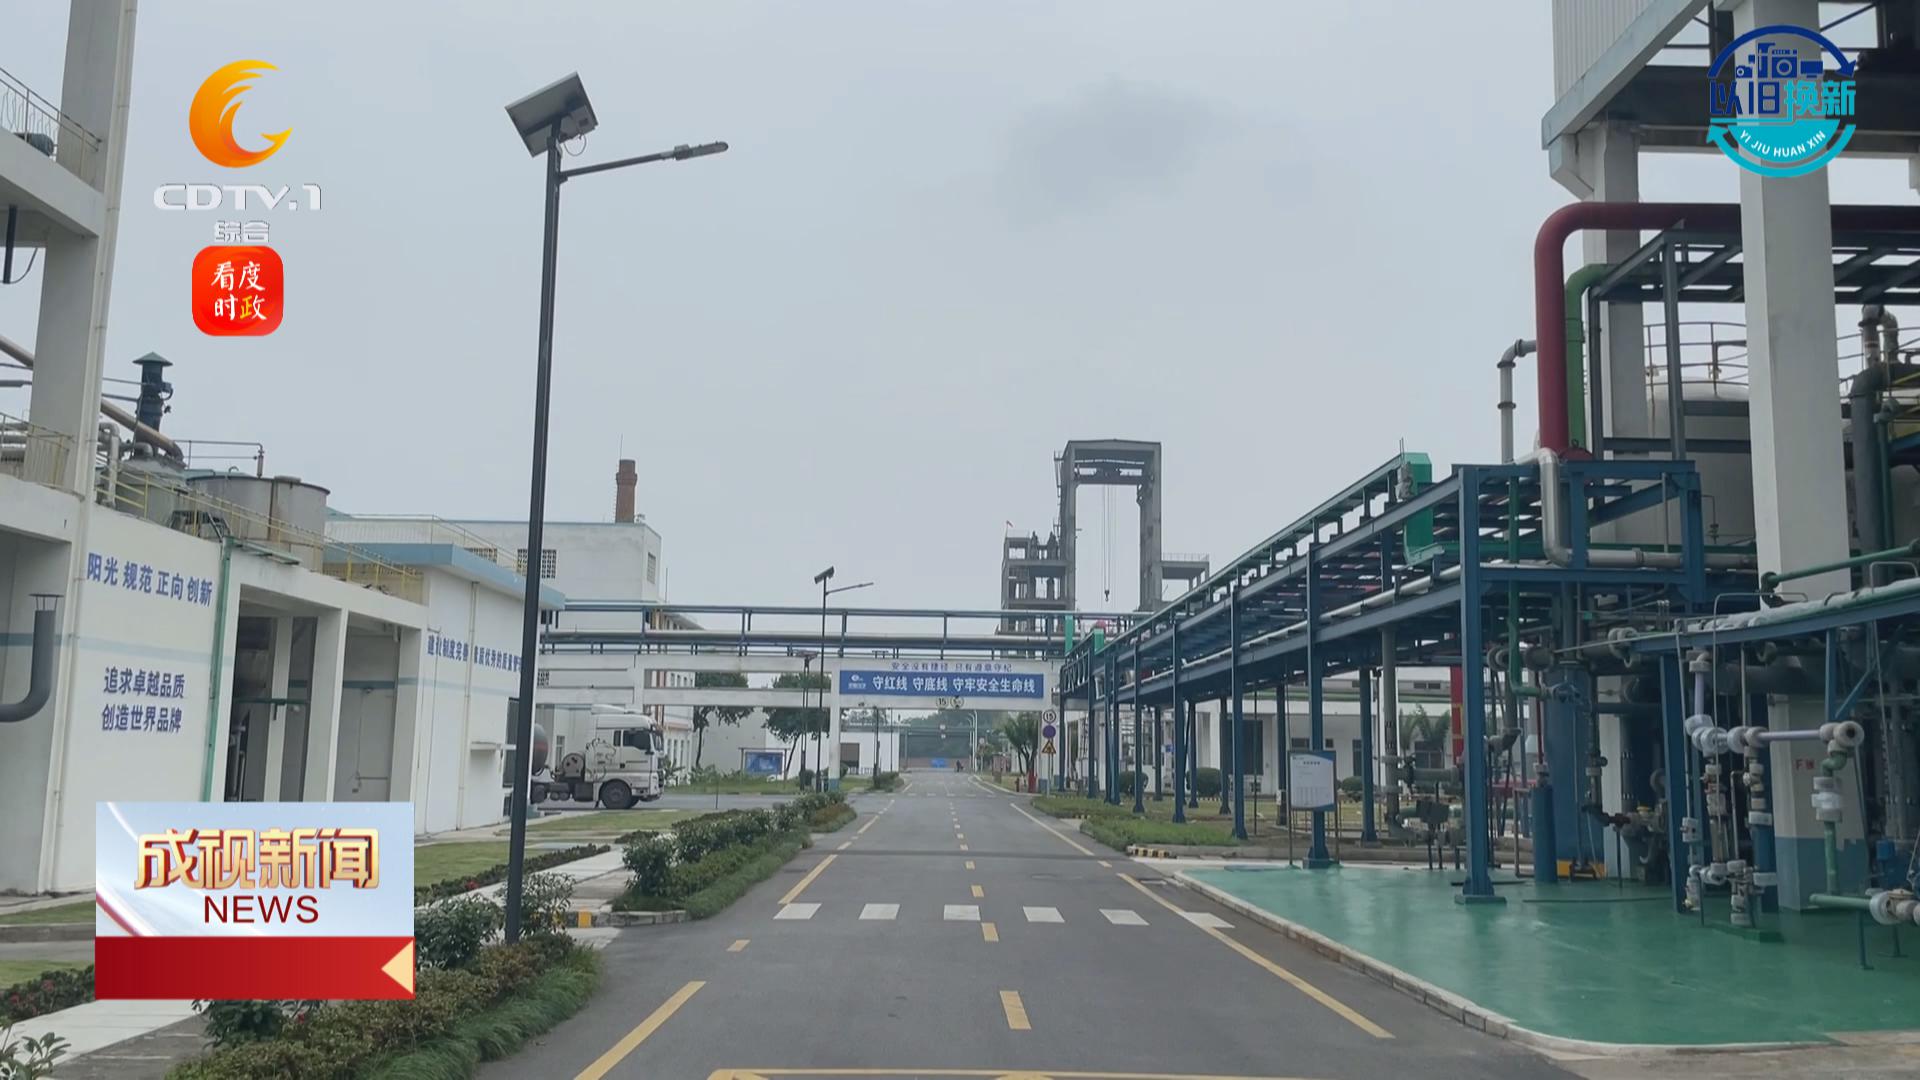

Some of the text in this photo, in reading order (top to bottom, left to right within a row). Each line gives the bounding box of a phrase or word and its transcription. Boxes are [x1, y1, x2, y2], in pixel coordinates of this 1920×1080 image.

[86, 552, 213, 607] 阳光 规范 正向 创新
[103, 666, 185, 699] 追求卓越品质
[872, 675, 908, 691] 守红线
[913, 677, 948, 692] 守底线
[953, 678, 1035, 693] 守牢安全生命线
[101, 703, 183, 734] 创造世界品牌
